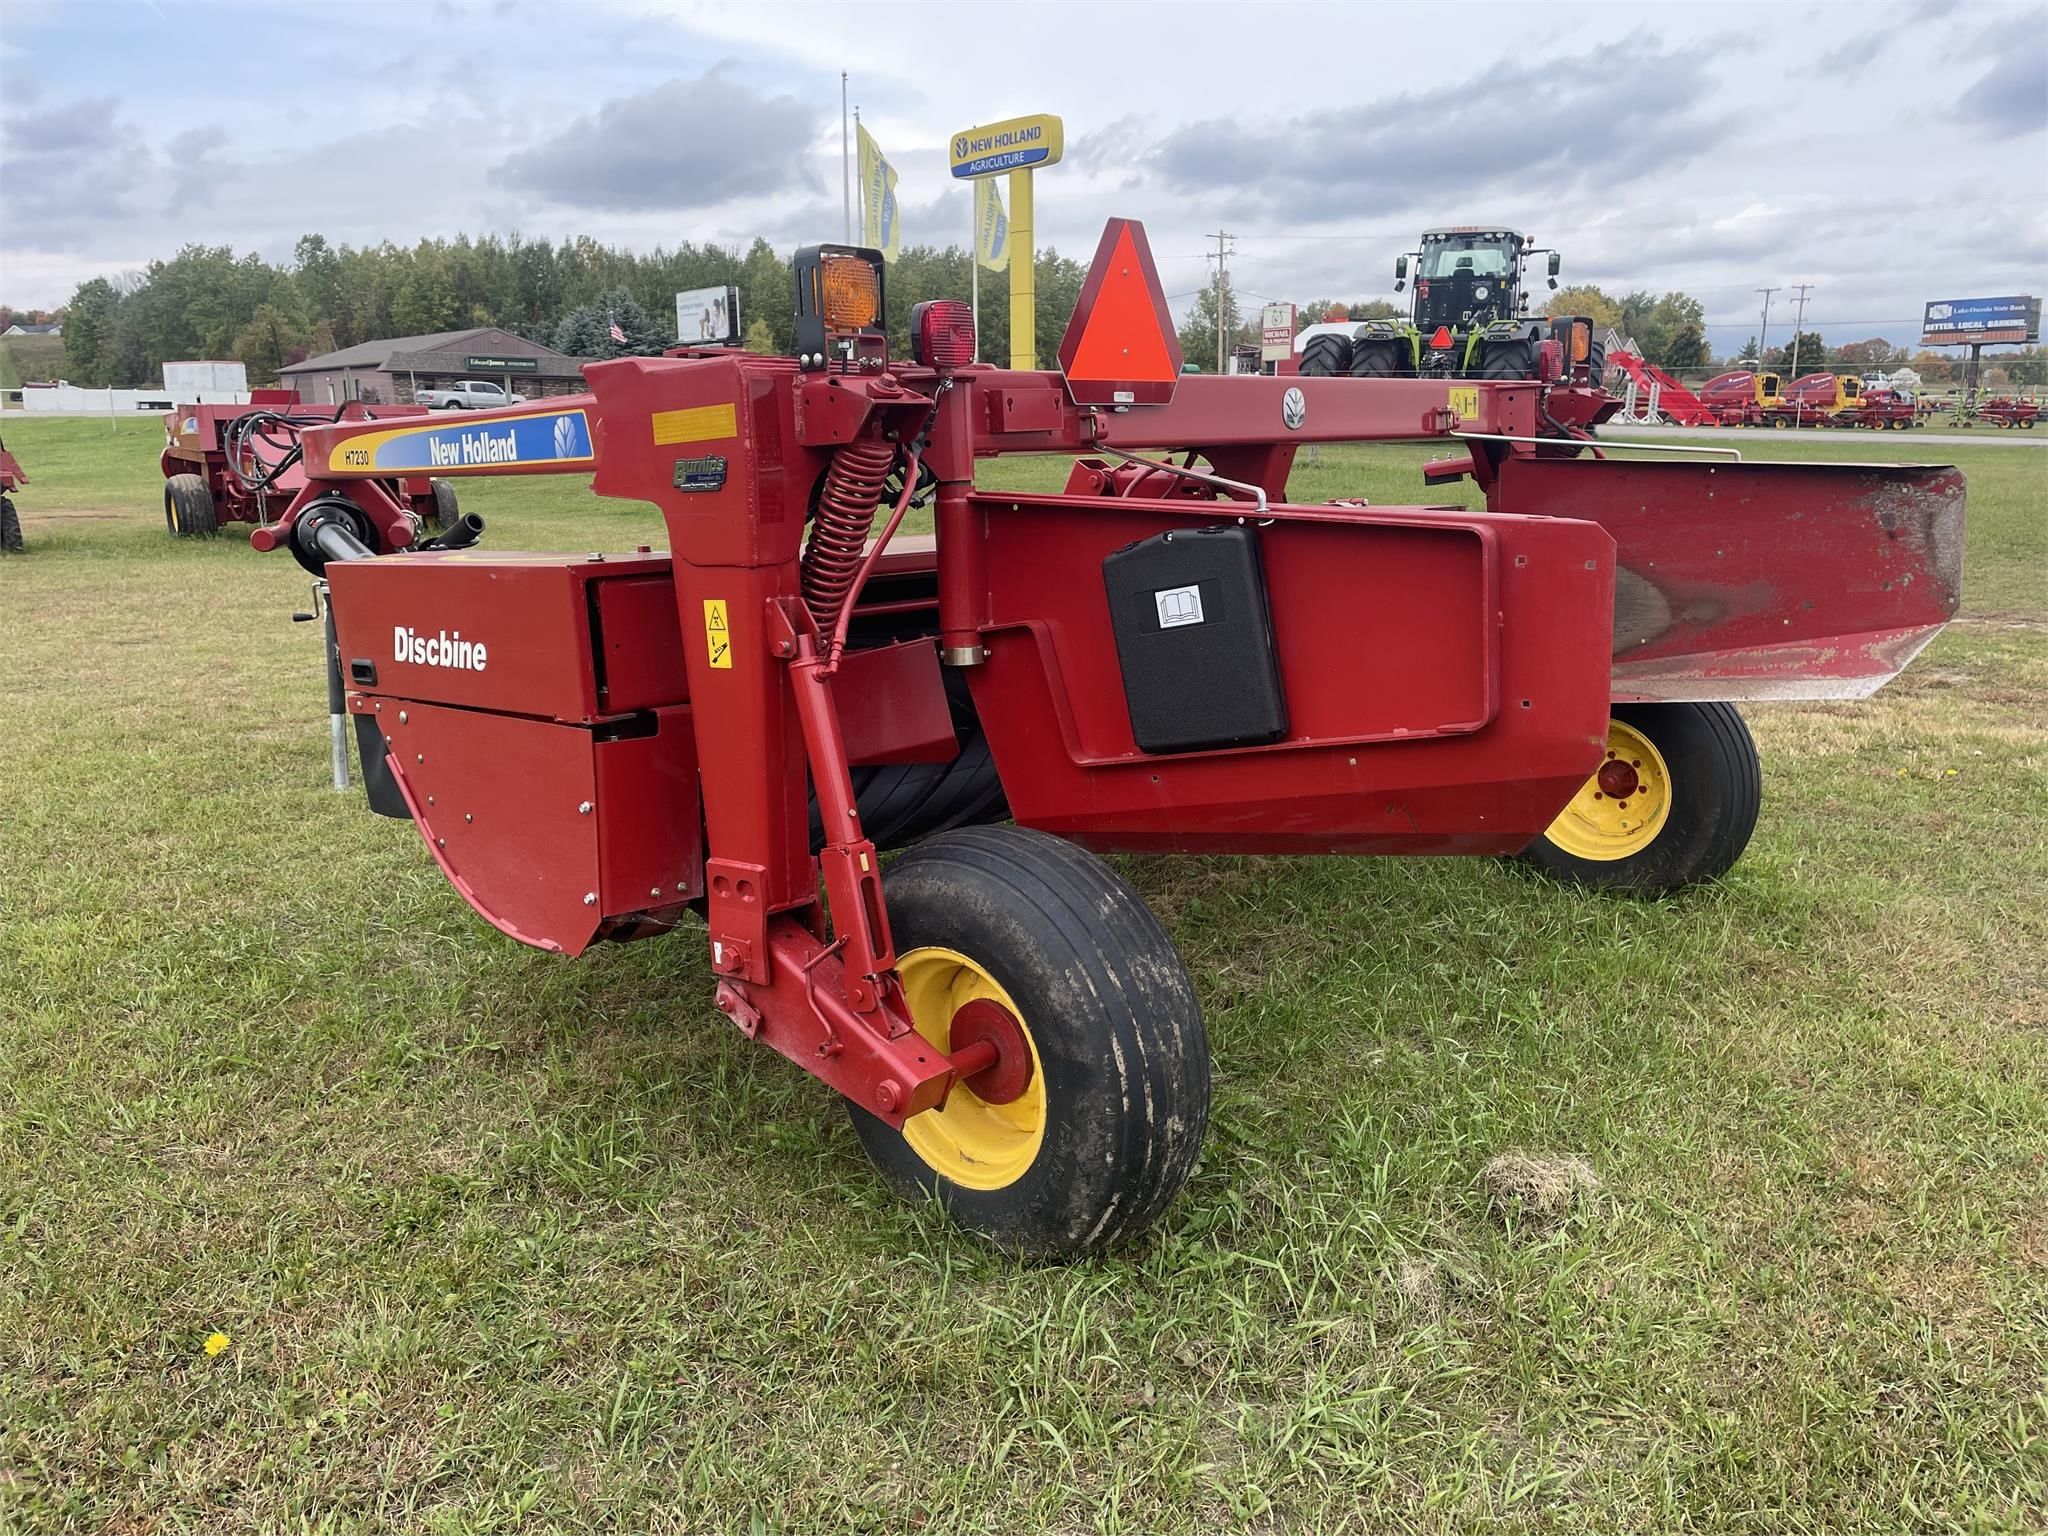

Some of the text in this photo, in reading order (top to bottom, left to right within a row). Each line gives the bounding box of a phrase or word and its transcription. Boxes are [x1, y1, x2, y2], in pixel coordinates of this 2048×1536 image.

[970, 126, 1041, 153] NEW HOLLAND
[970, 151, 1025, 172] AGRICULTURE
[1957, 321, 1985, 329] LOCAL.
[344, 450, 369, 466] H7230
[429, 429, 517, 466] New Holland
[673, 456, 724, 485] Burnips
[394, 626, 487, 671] Discbine
